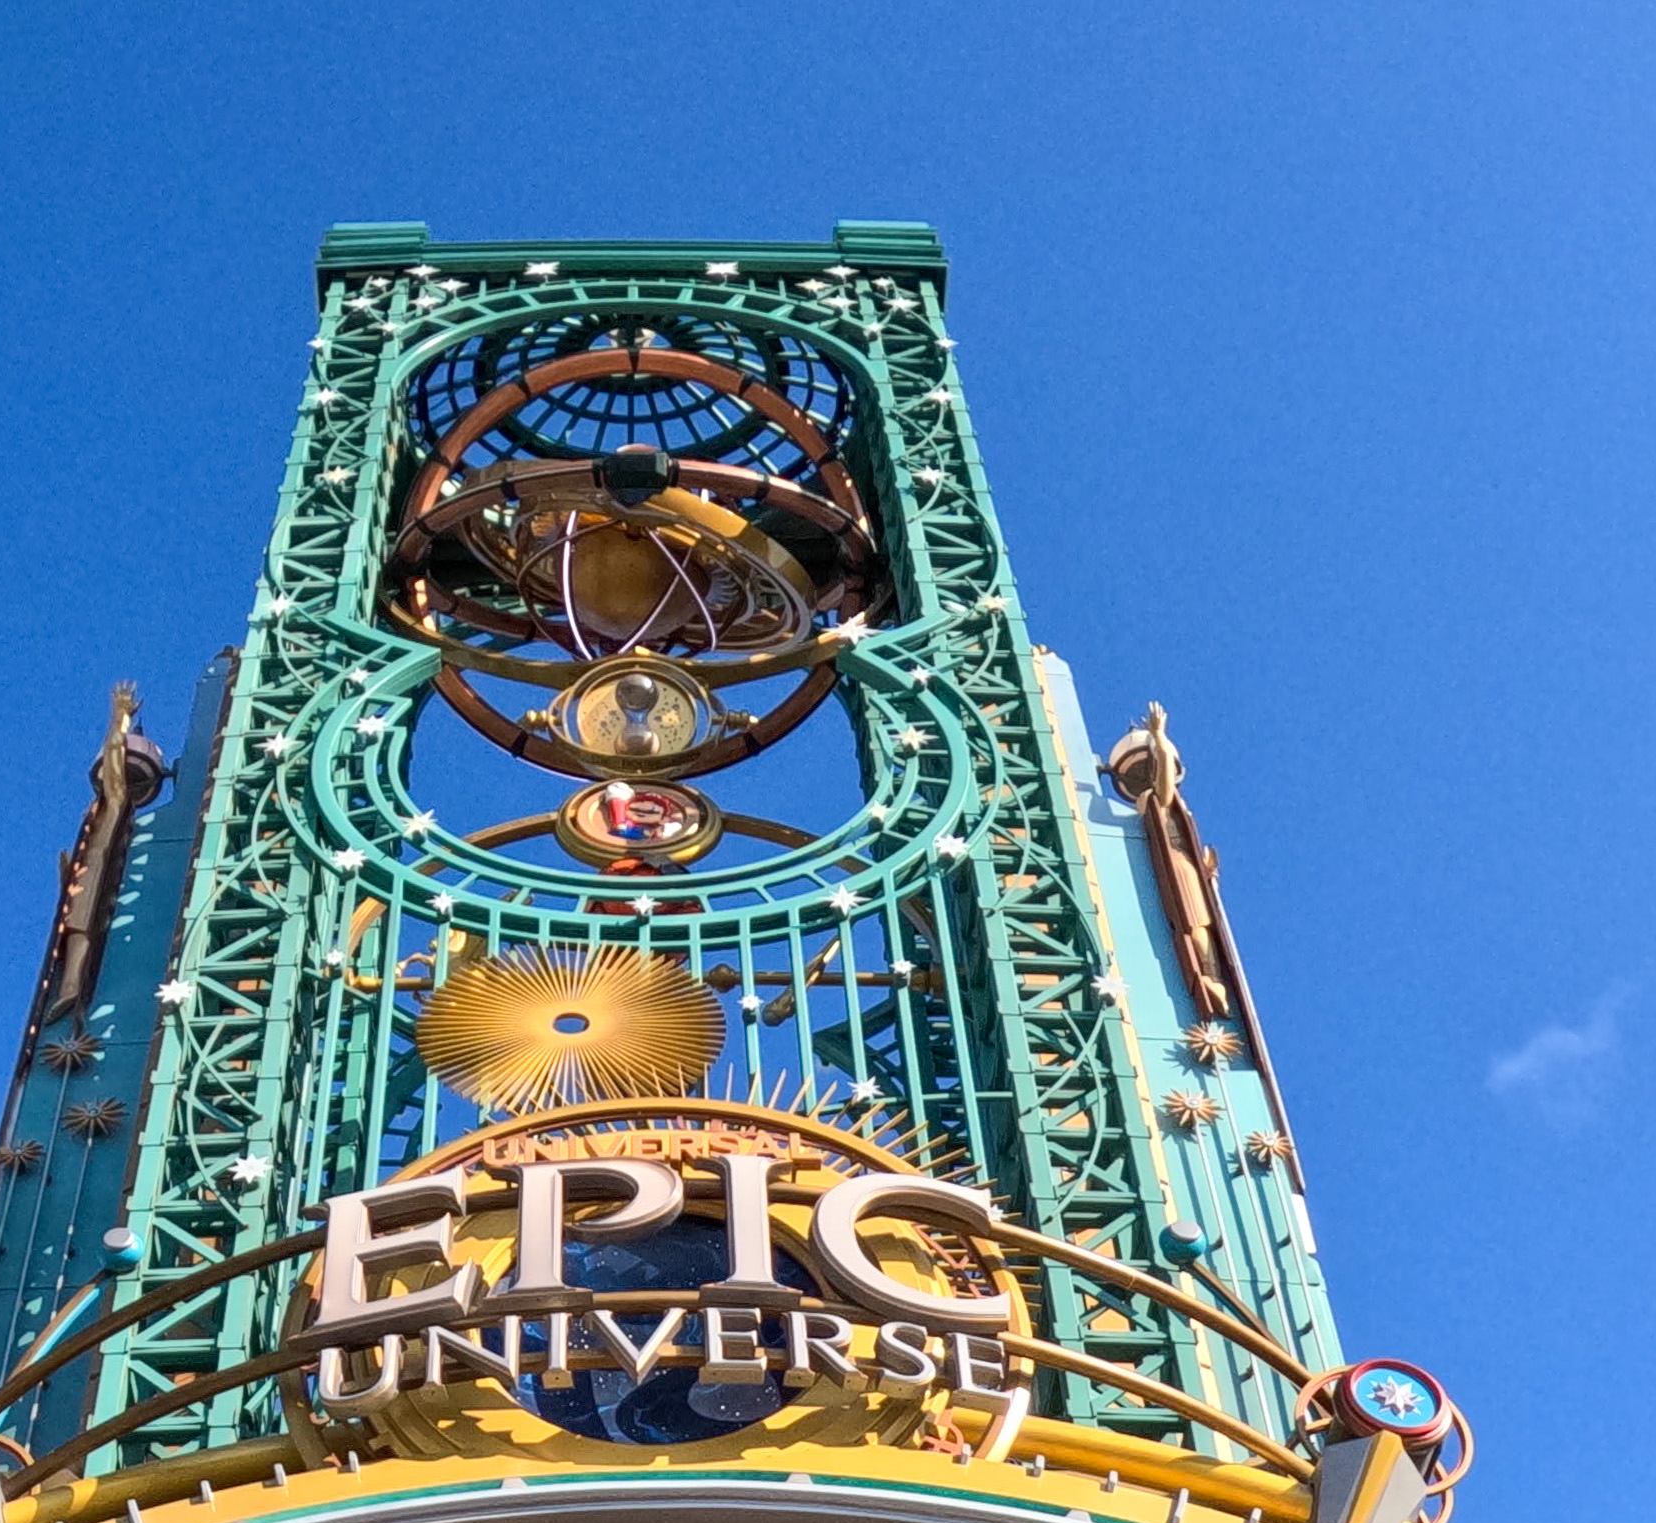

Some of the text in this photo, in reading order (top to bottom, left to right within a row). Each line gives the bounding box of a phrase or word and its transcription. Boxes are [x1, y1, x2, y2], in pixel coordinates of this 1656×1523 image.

[483, 1131, 822, 1170] UNIVERSAL
[303, 1154, 1012, 1336] EPIC
[317, 1307, 1015, 1412] UNIVERSE
